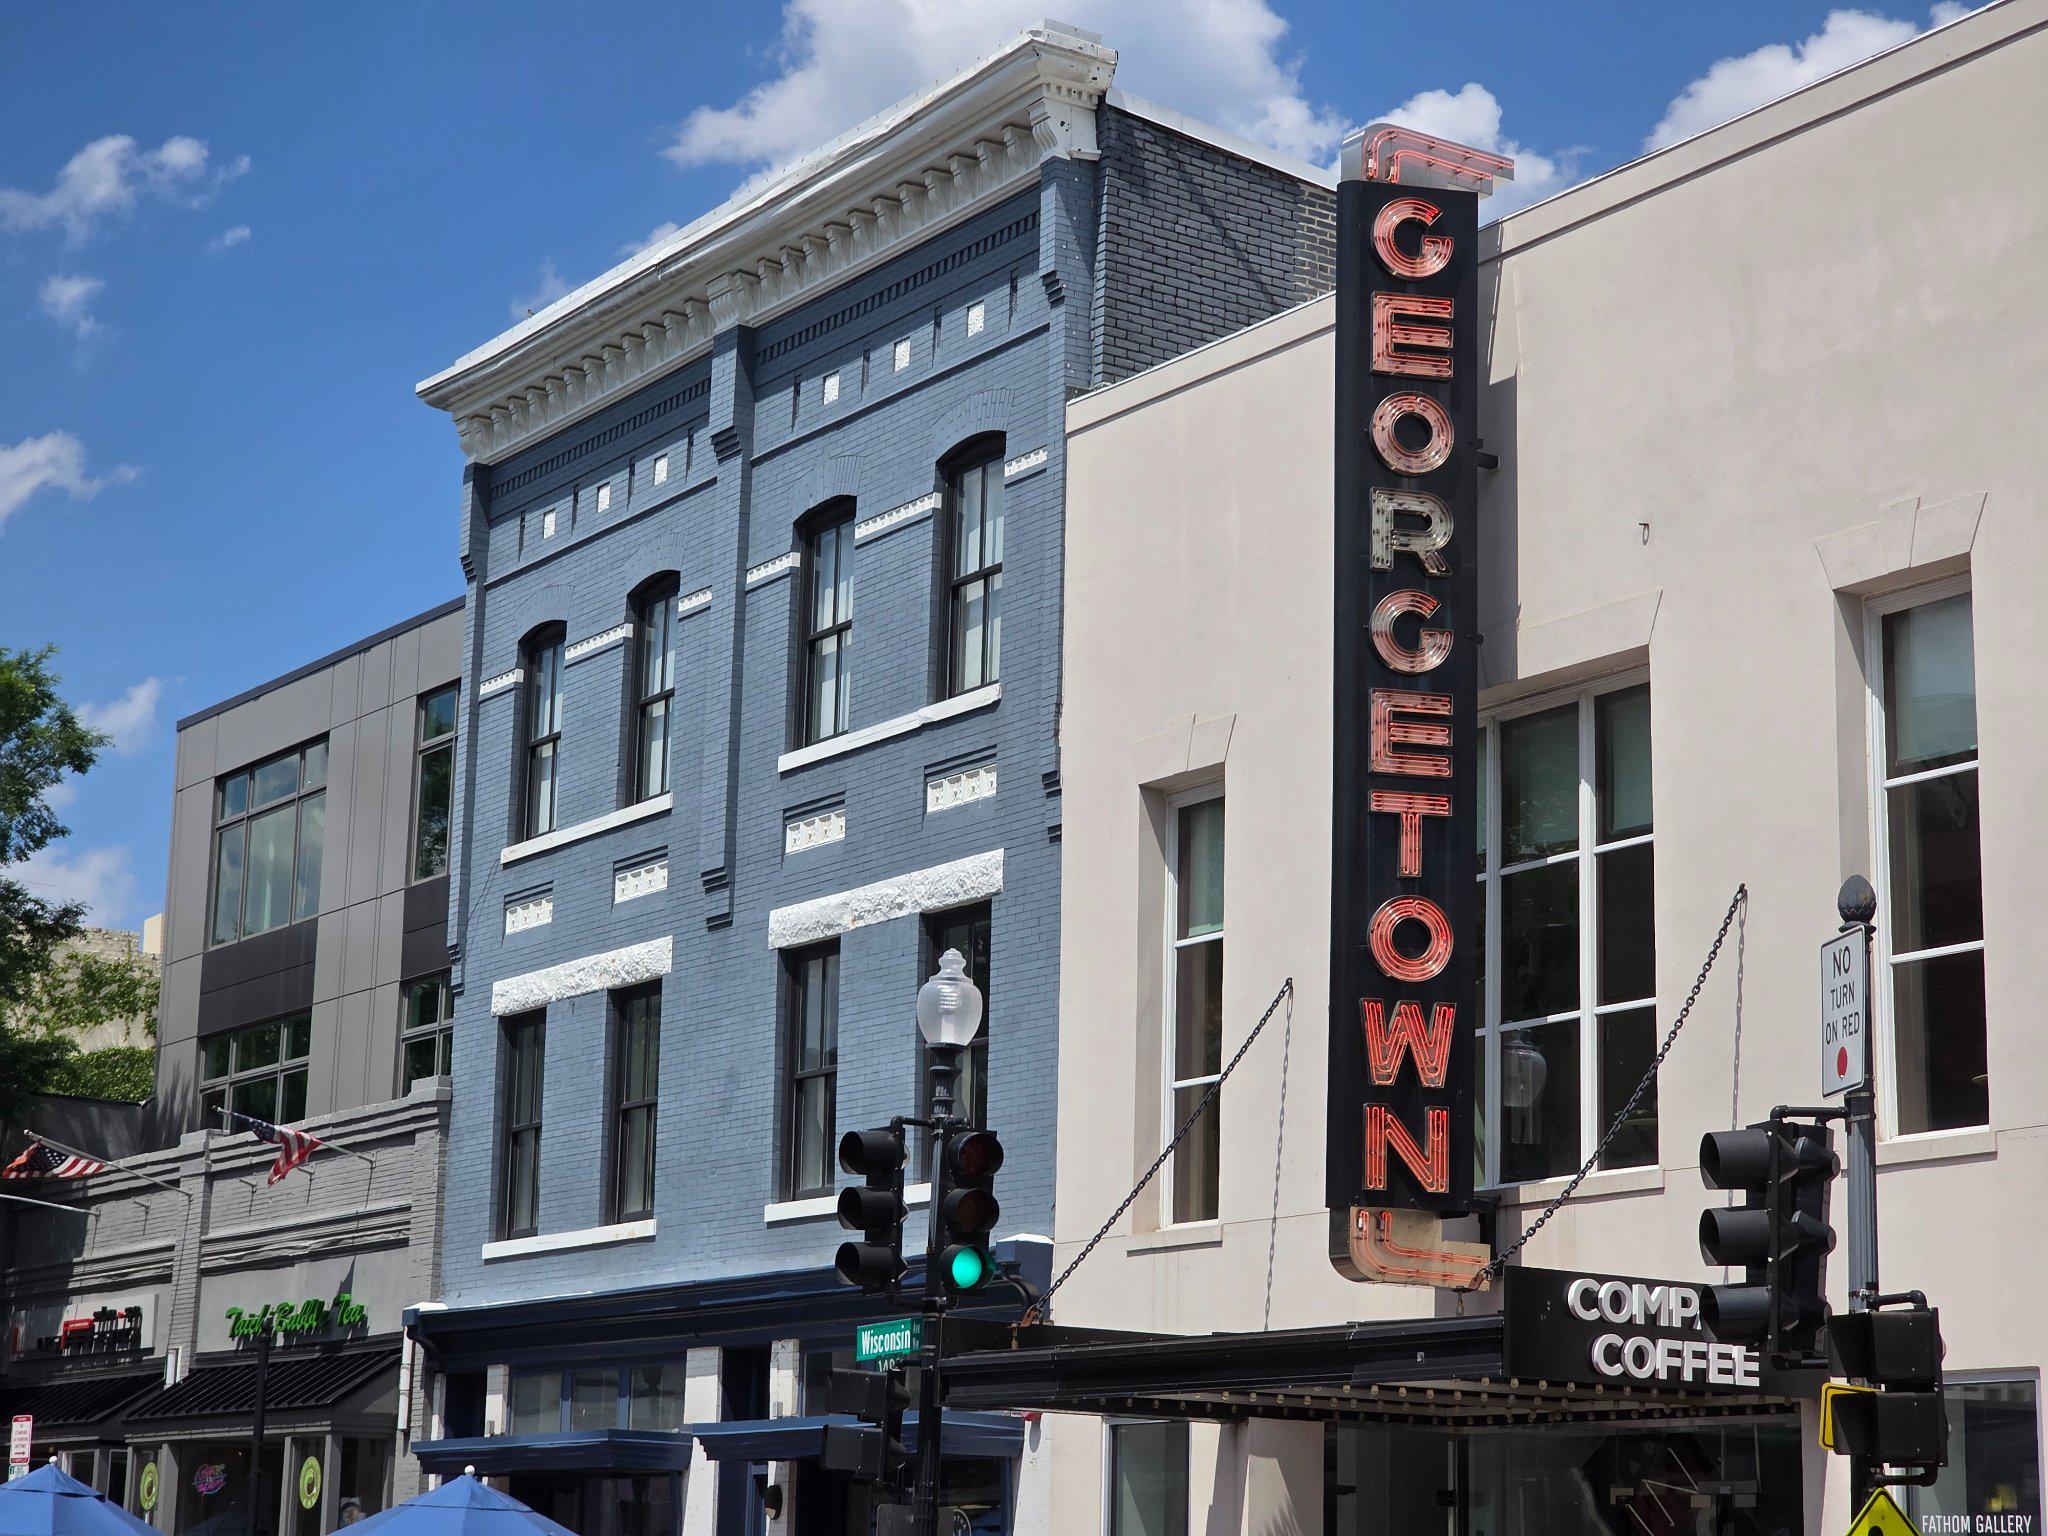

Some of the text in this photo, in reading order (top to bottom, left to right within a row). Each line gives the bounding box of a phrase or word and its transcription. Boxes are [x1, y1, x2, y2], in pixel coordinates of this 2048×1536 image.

[1360, 196, 1455, 1193] GEORGETOWN
[1833, 945, 1851, 978] NO
[1830, 981, 1855, 1011] TURN
[1825, 1011, 1860, 1045] ON RED
[1567, 1278, 1702, 1330] COMP
[861, 1324, 911, 1355] Wisconsin
[1591, 1333, 1760, 1387] COFFEE
[1921, 1514, 2032, 1533] FATHOM GALLERY
